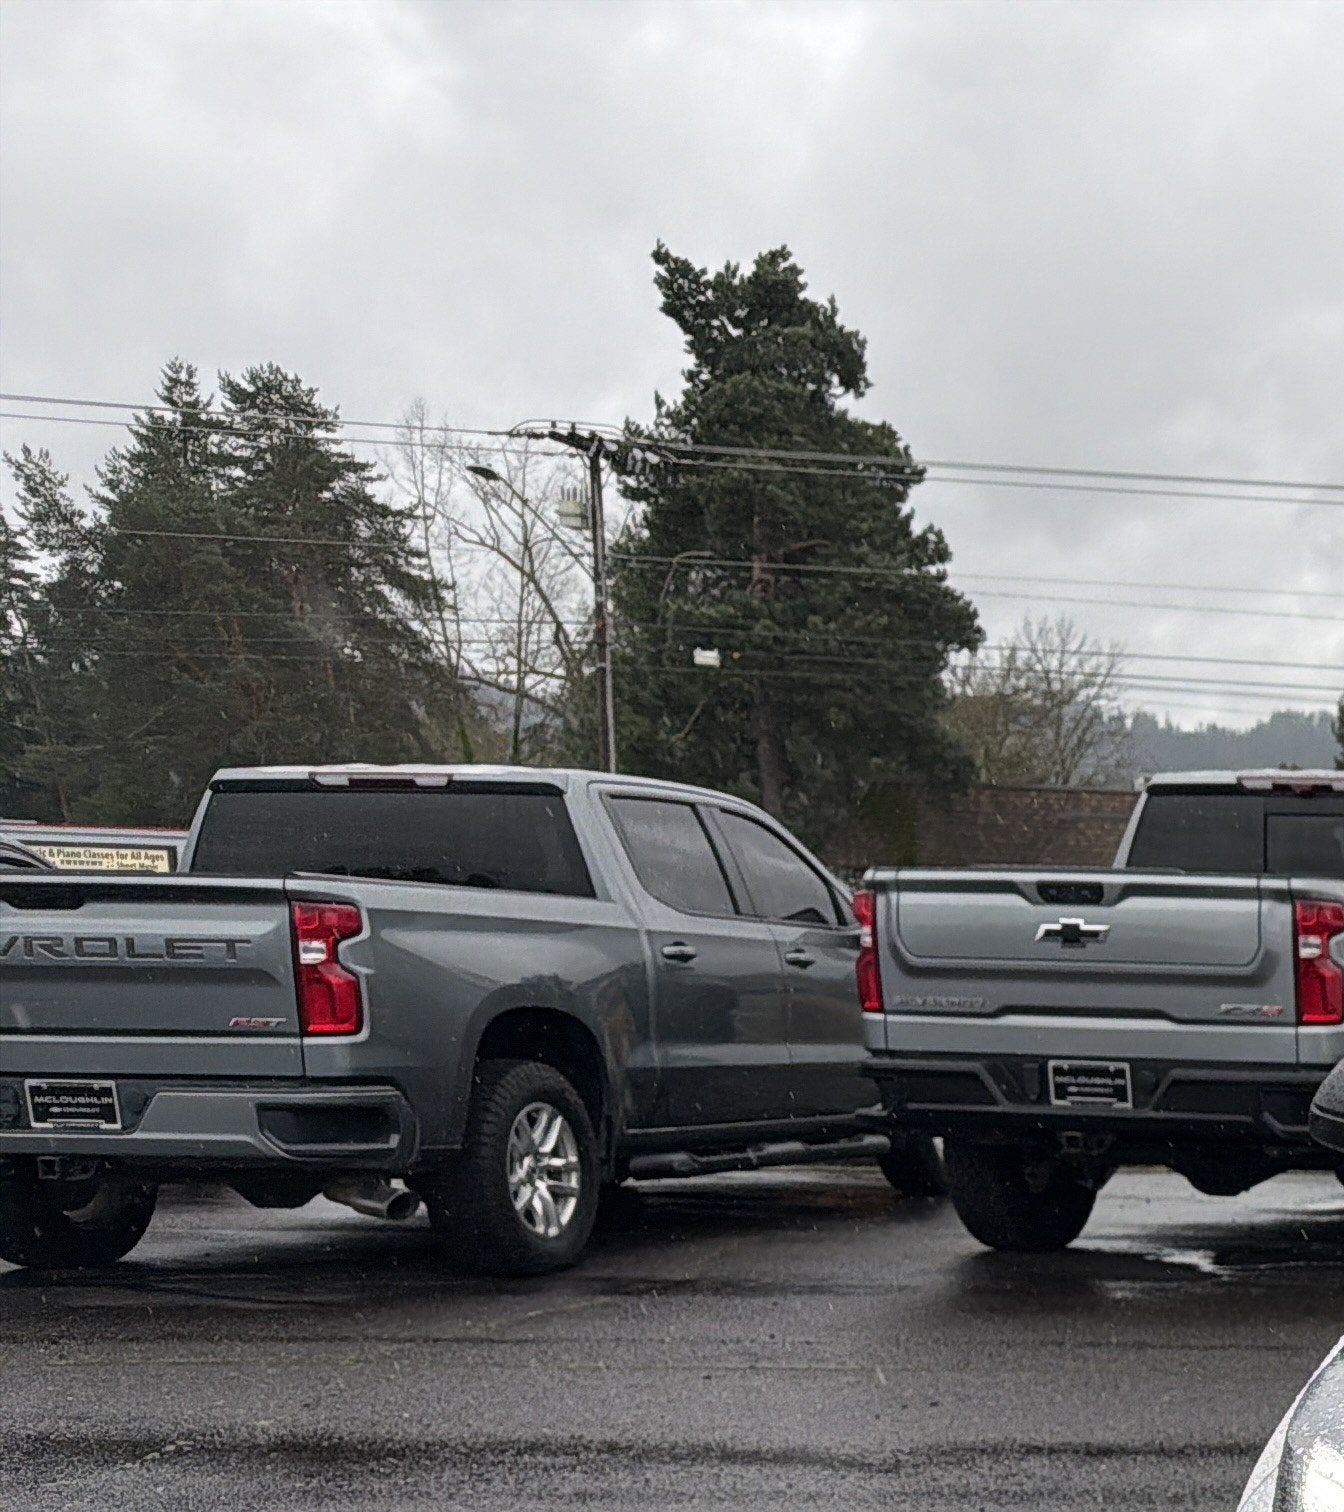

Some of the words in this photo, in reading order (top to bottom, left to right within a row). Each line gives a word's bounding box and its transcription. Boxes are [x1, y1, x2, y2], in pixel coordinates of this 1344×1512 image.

[57, 849, 82, 858] Piano
[83, 850, 114, 860] Classes
[116, 851, 128, 860] for
[131, 852, 142, 860] All
[144, 852, 165, 864] Ages
[34, 1095, 113, 1104] MCLOUGHLIN
